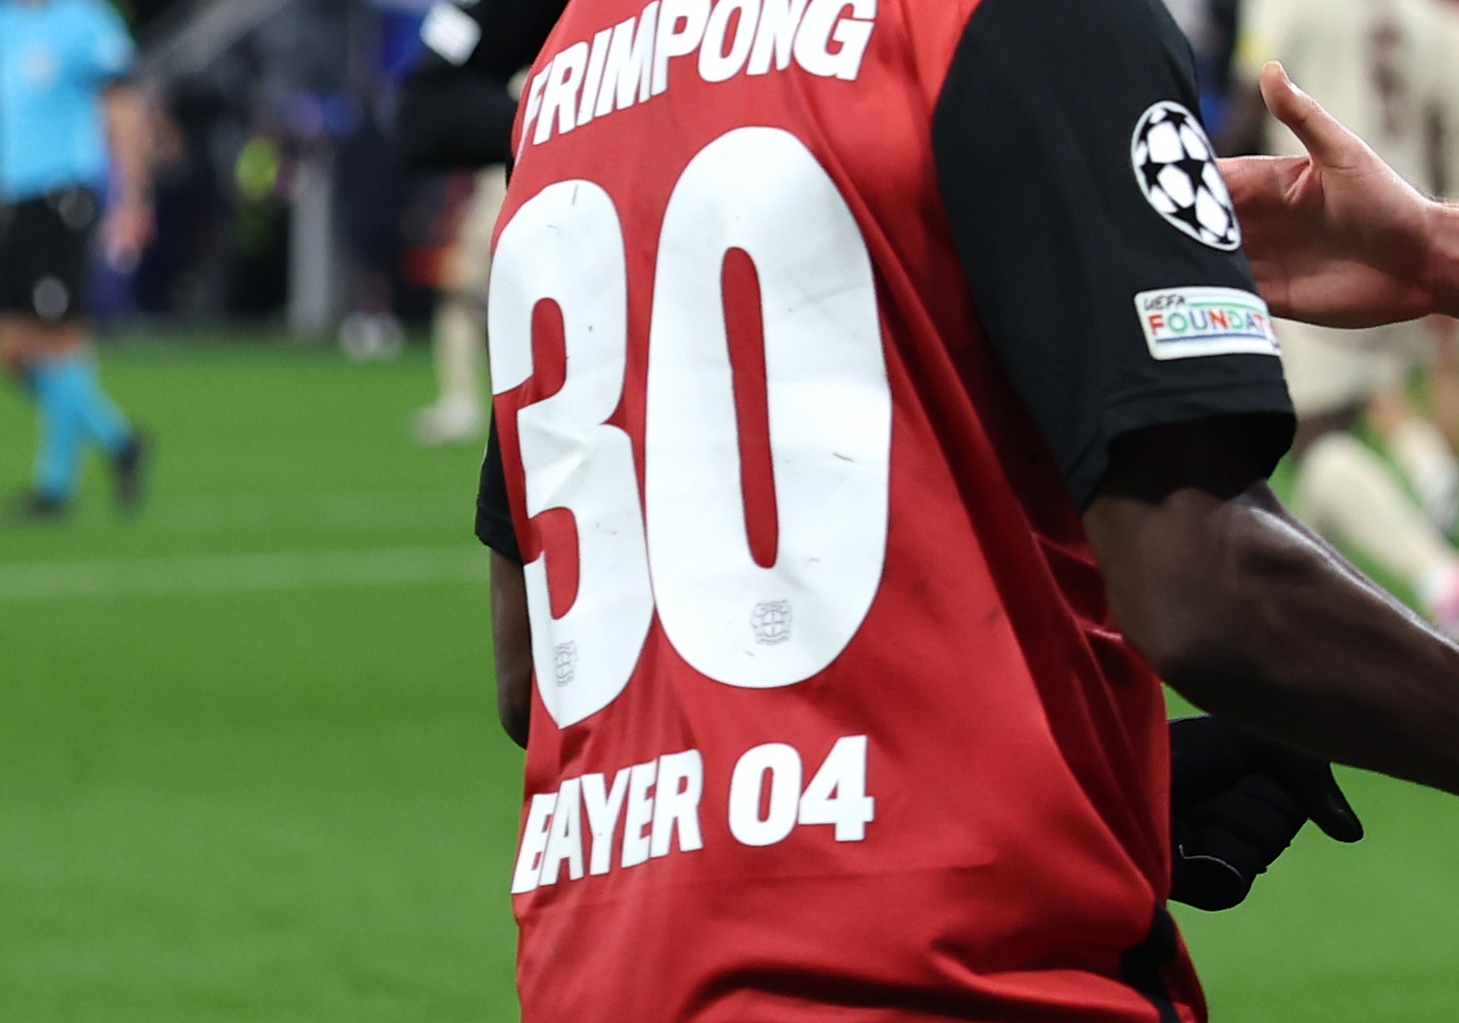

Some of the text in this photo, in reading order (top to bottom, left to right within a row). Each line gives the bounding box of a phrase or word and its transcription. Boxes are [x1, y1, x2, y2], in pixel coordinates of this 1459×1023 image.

[1144, 293, 1187, 311] UEFA
[1147, 308, 1268, 336] FOUNDAT
[487, 125, 893, 730] 30
[510, 734, 876, 894] BAYER 04
